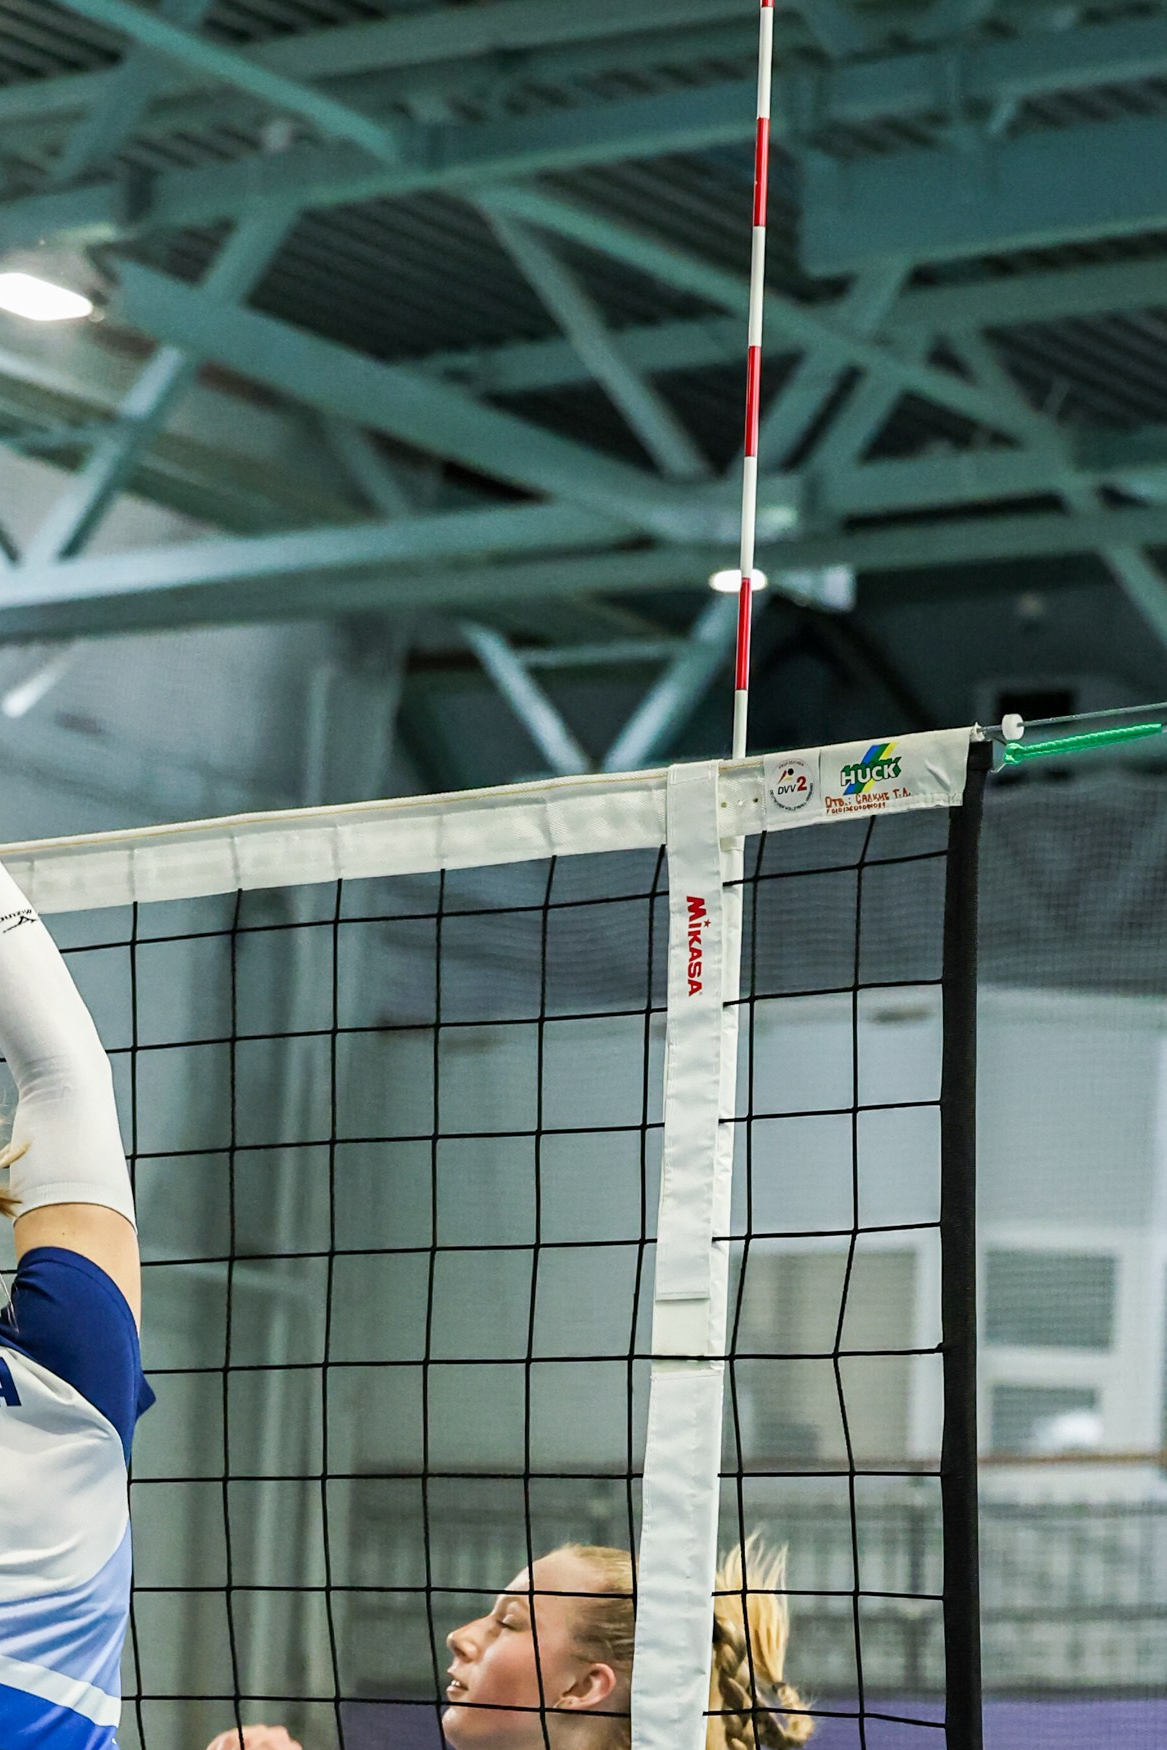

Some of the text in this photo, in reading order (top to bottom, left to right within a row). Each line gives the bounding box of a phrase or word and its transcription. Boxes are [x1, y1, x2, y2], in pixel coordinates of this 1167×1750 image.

[777, 776, 808, 795] DVV 2
[840, 758, 900, 787] HUCK
[686, 895, 711, 997] MIKASA
